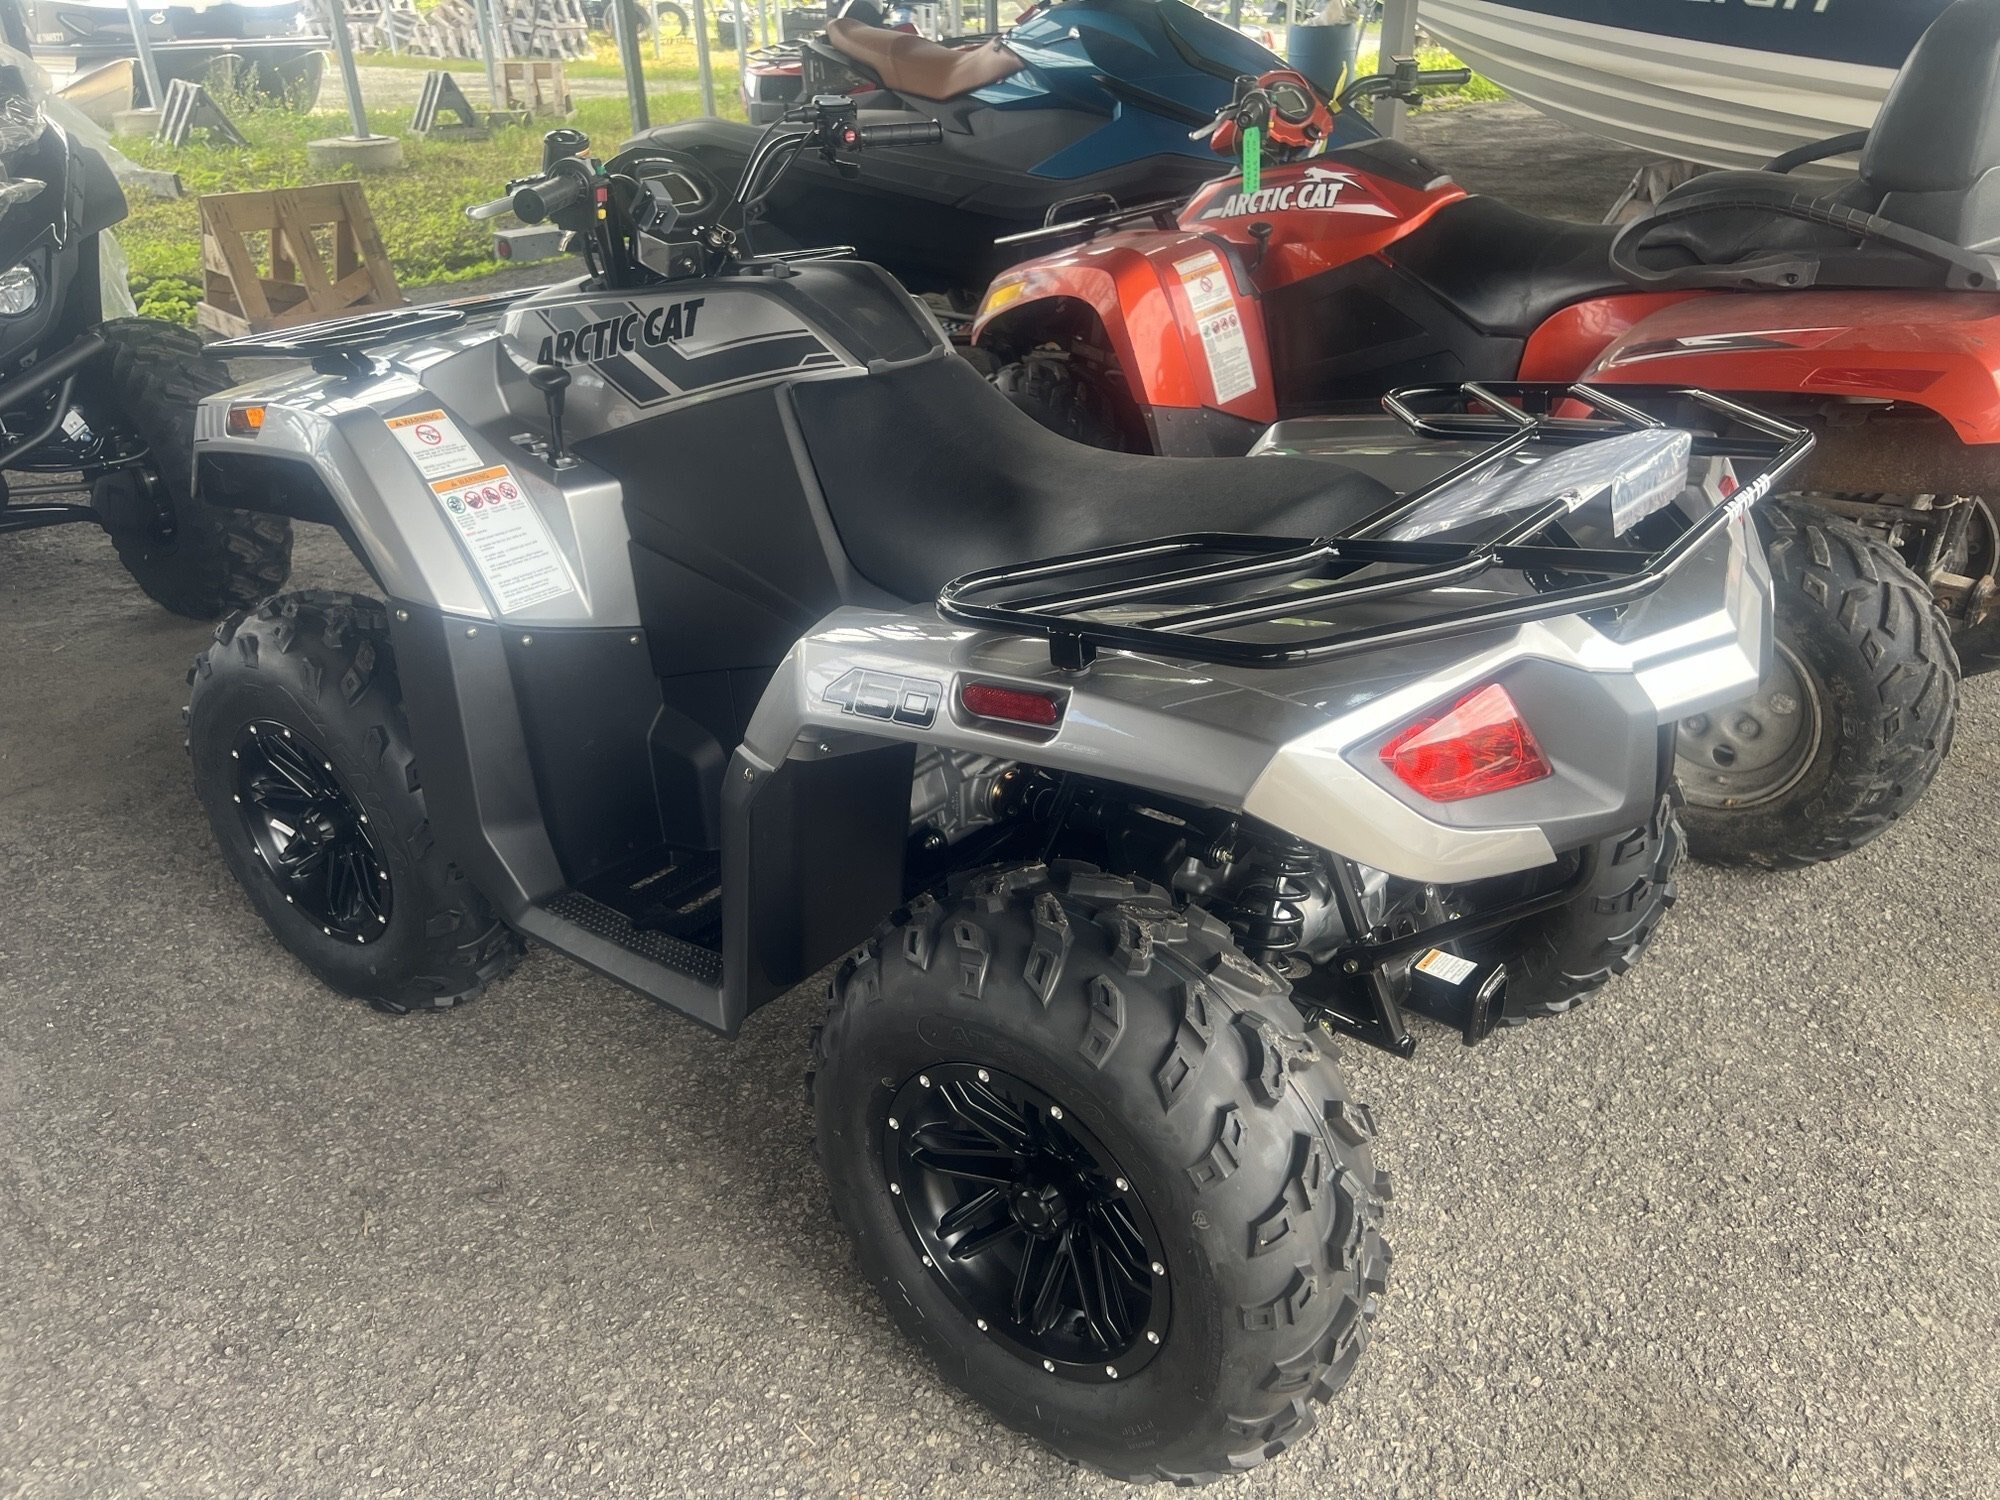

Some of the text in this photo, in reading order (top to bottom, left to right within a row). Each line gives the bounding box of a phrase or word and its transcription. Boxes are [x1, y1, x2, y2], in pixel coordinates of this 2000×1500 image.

[1220, 183, 1344, 219] ARCTIC CAT
[537, 298, 706, 367] ARCTIC CAT
[822, 667, 943, 730] 450
